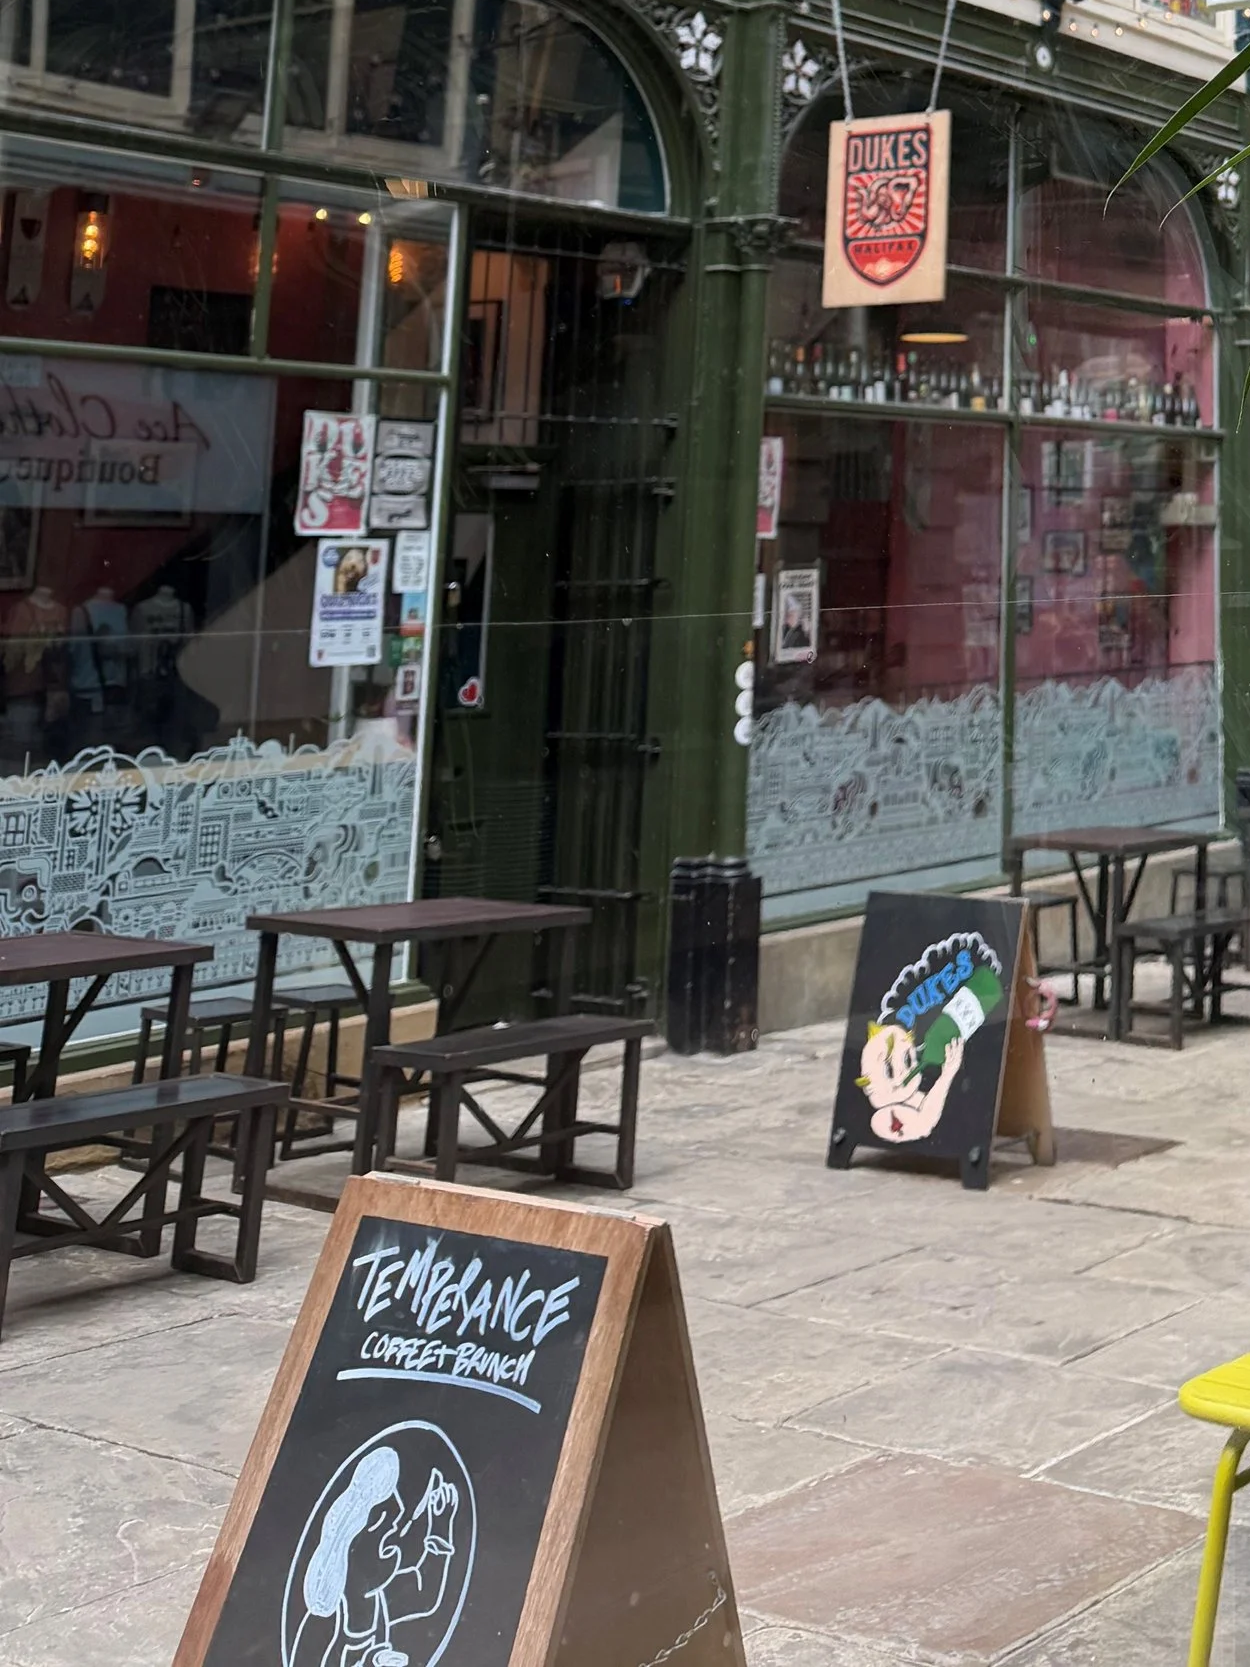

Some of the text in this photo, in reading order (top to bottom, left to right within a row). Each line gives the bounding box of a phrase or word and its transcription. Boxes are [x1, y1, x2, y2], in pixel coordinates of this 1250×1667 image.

[850, 130, 929, 172] DUKES
[854, 240, 914, 255] HALIFAX
[895, 949, 974, 1030] DUKES
[353, 1242, 580, 1347] TEMPERANCE
